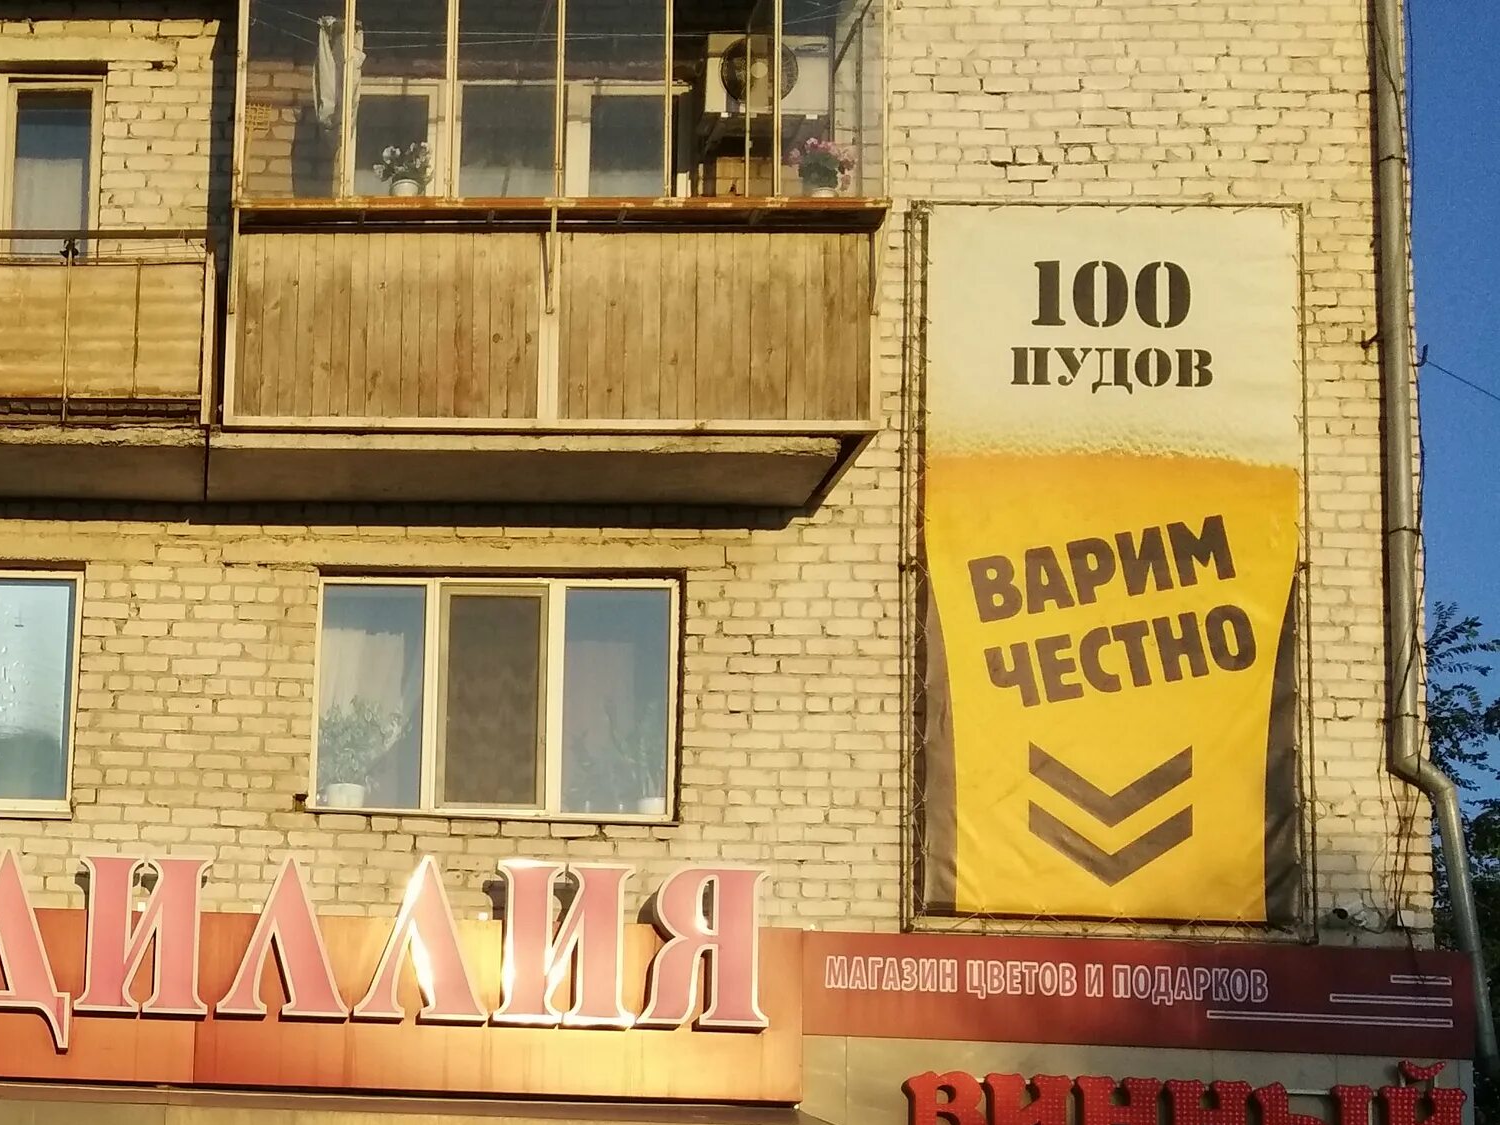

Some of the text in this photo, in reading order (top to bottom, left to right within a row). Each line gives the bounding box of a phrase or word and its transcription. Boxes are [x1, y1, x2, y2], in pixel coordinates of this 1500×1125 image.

[1031, 260, 1191, 329] 100
[1010, 347, 1214, 394] ПУДОВ
[967, 514, 1237, 623] ВАРИМ
[983, 604, 1257, 708] ЧЕСТНО
[824, 955, 1269, 1005] МАГАЗИН ЦВЕТОВ И ПОДАРКОВ
